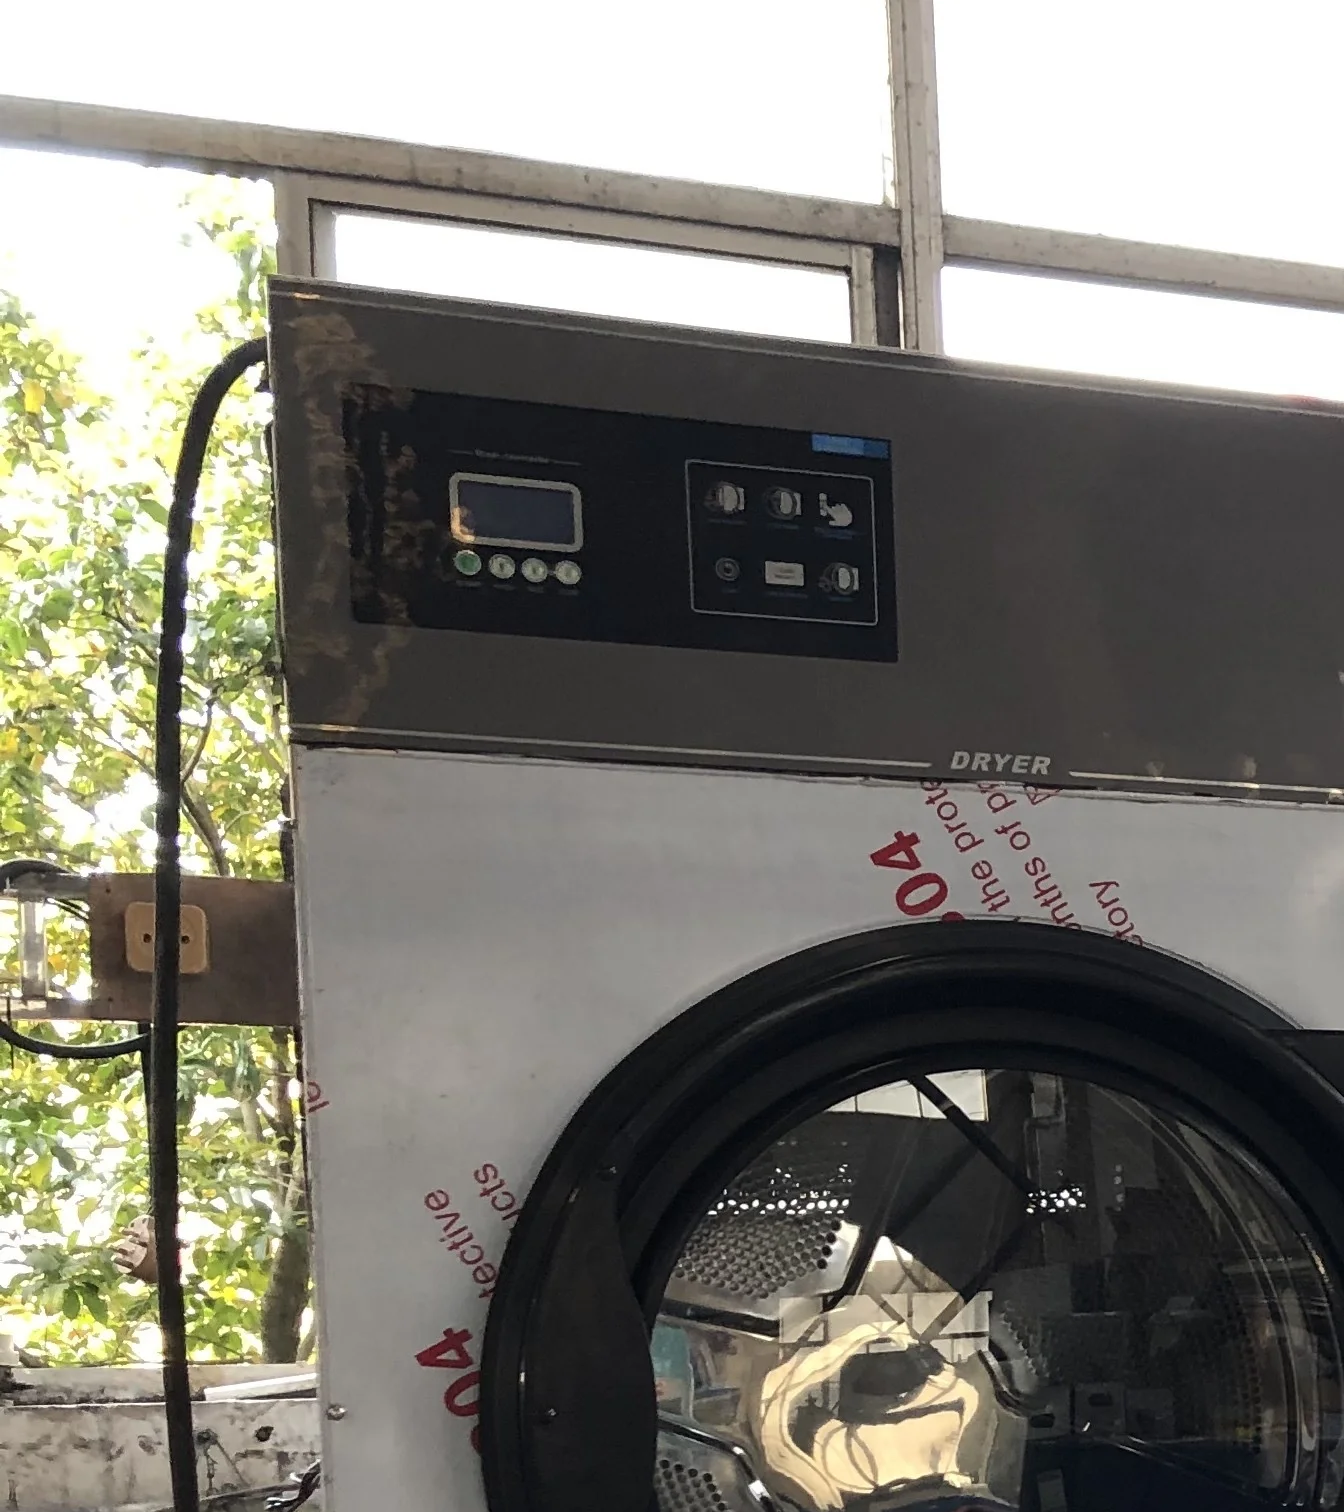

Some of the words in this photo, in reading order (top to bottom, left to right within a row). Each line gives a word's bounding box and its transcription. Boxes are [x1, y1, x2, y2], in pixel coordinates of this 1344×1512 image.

[950, 751, 1051, 775] DRYER
[994, 820, 1032, 851] of
[869, 830, 965, 923] 04
[970, 859, 1011, 913] the
